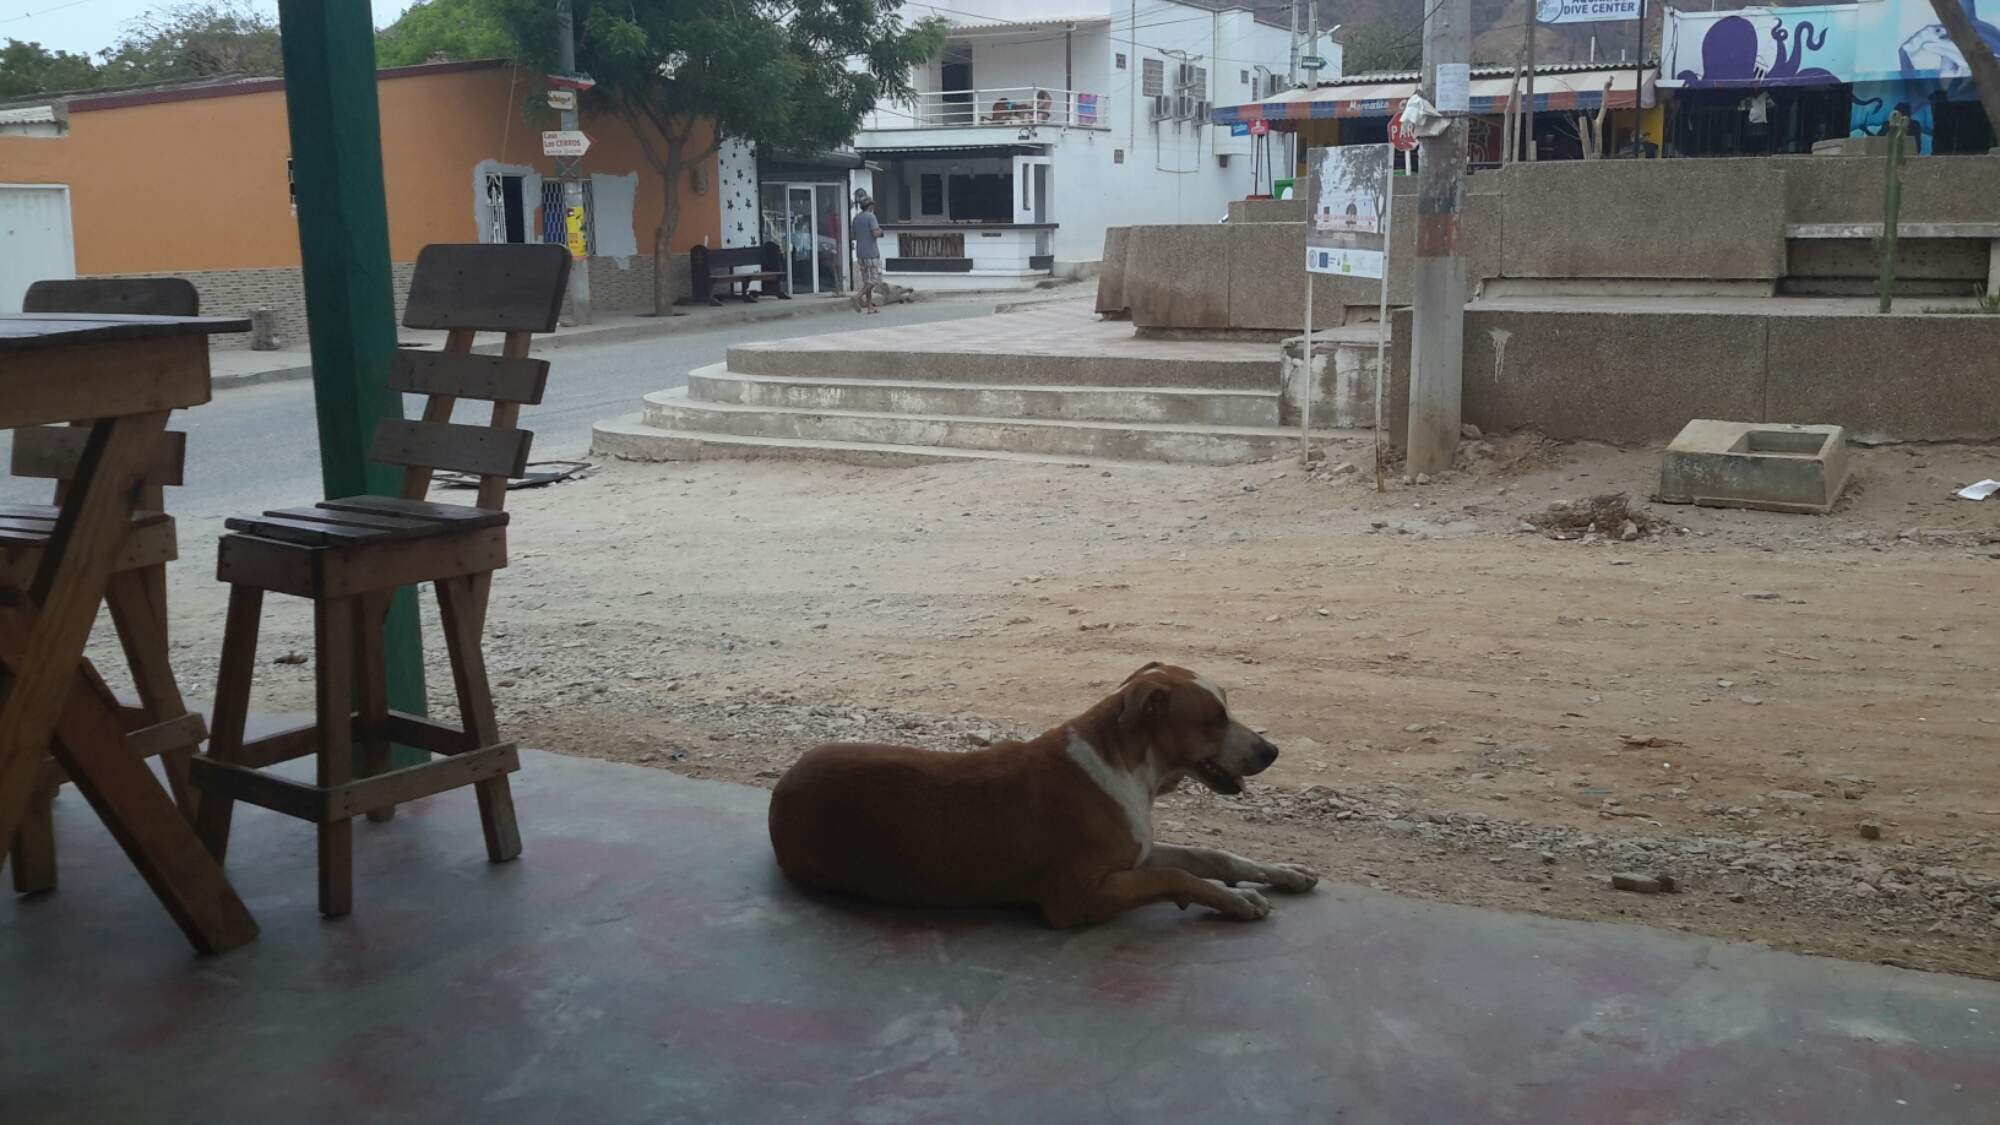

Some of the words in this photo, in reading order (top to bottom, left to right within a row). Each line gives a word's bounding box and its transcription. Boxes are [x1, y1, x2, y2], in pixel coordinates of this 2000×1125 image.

[1564, 4, 1589, 15] DIVE
[1591, 3, 1634, 14] CENTER
[1391, 124, 1416, 140] PAR
